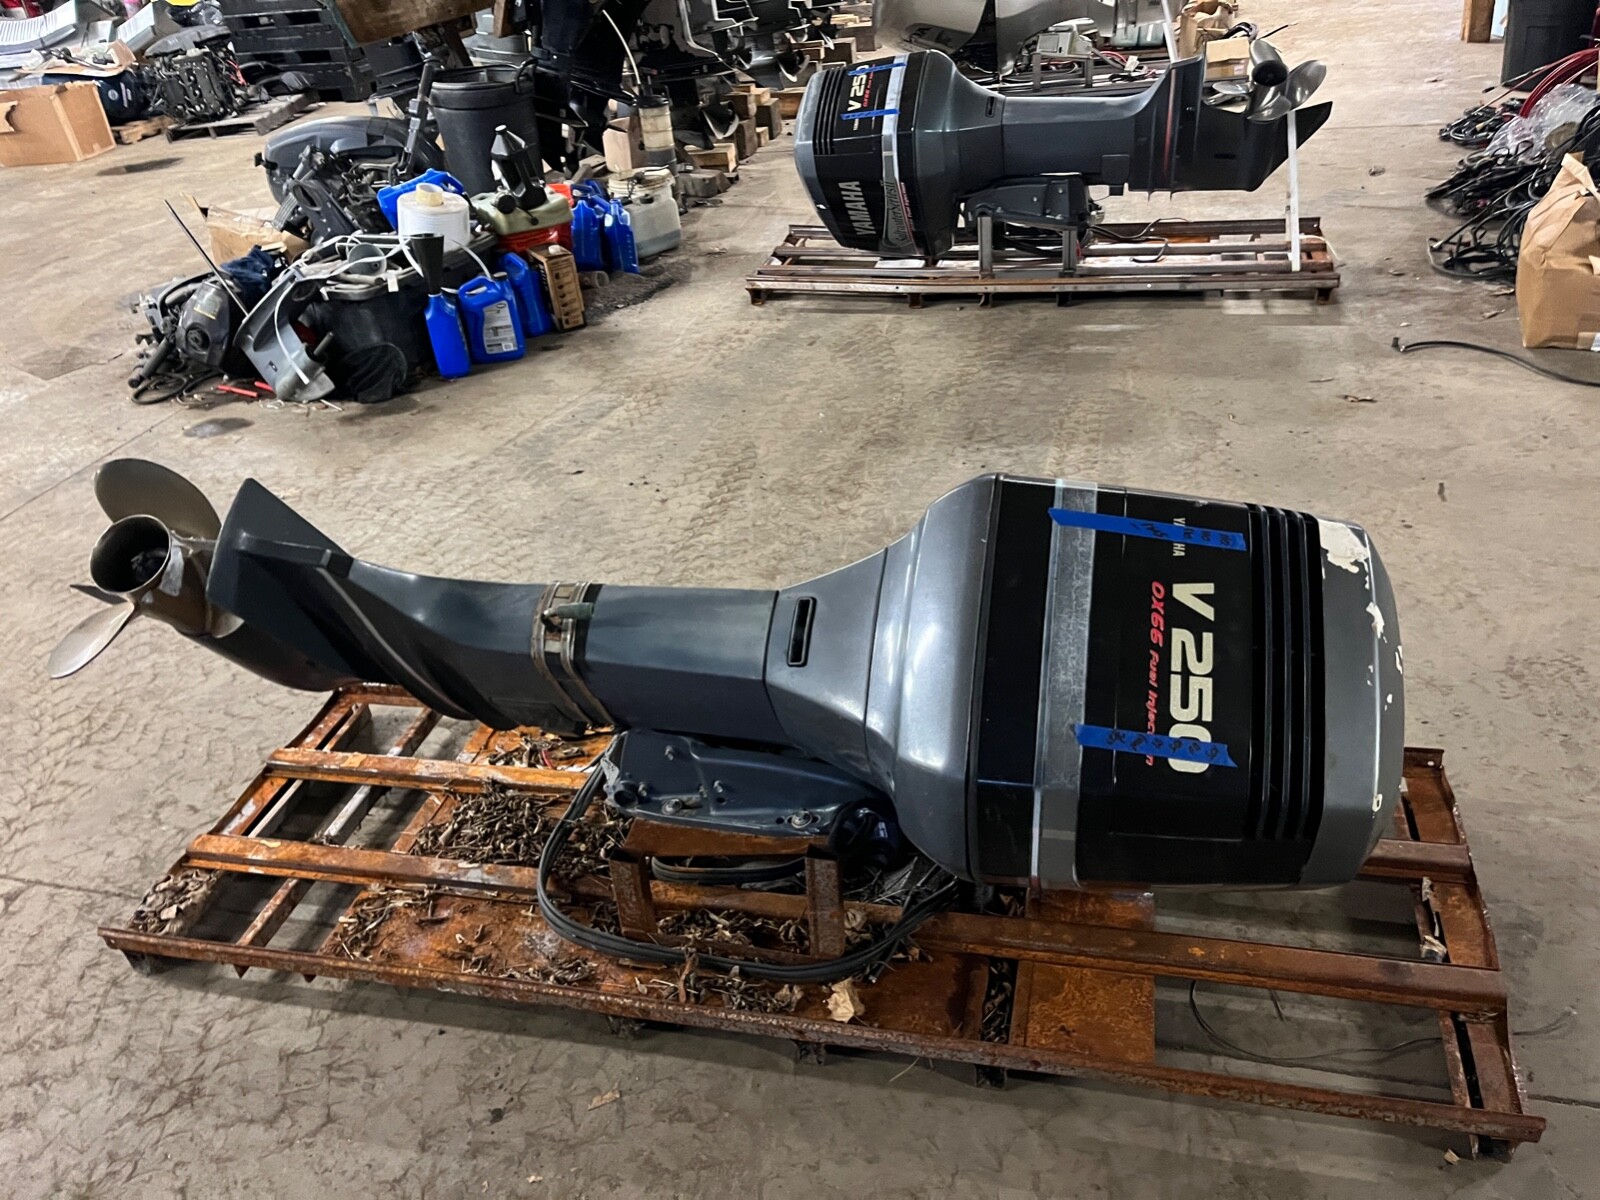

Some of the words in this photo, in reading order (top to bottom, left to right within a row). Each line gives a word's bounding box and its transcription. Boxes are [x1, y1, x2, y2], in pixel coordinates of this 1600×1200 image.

[847, 100, 862, 111] V
[838, 181, 877, 235] YAMAHA
[1150, 581, 1165, 647] OX66
[1172, 583, 1215, 622] V
[1149, 649, 1160, 688] Fuel
[1167, 627, 1214, 774] 250
